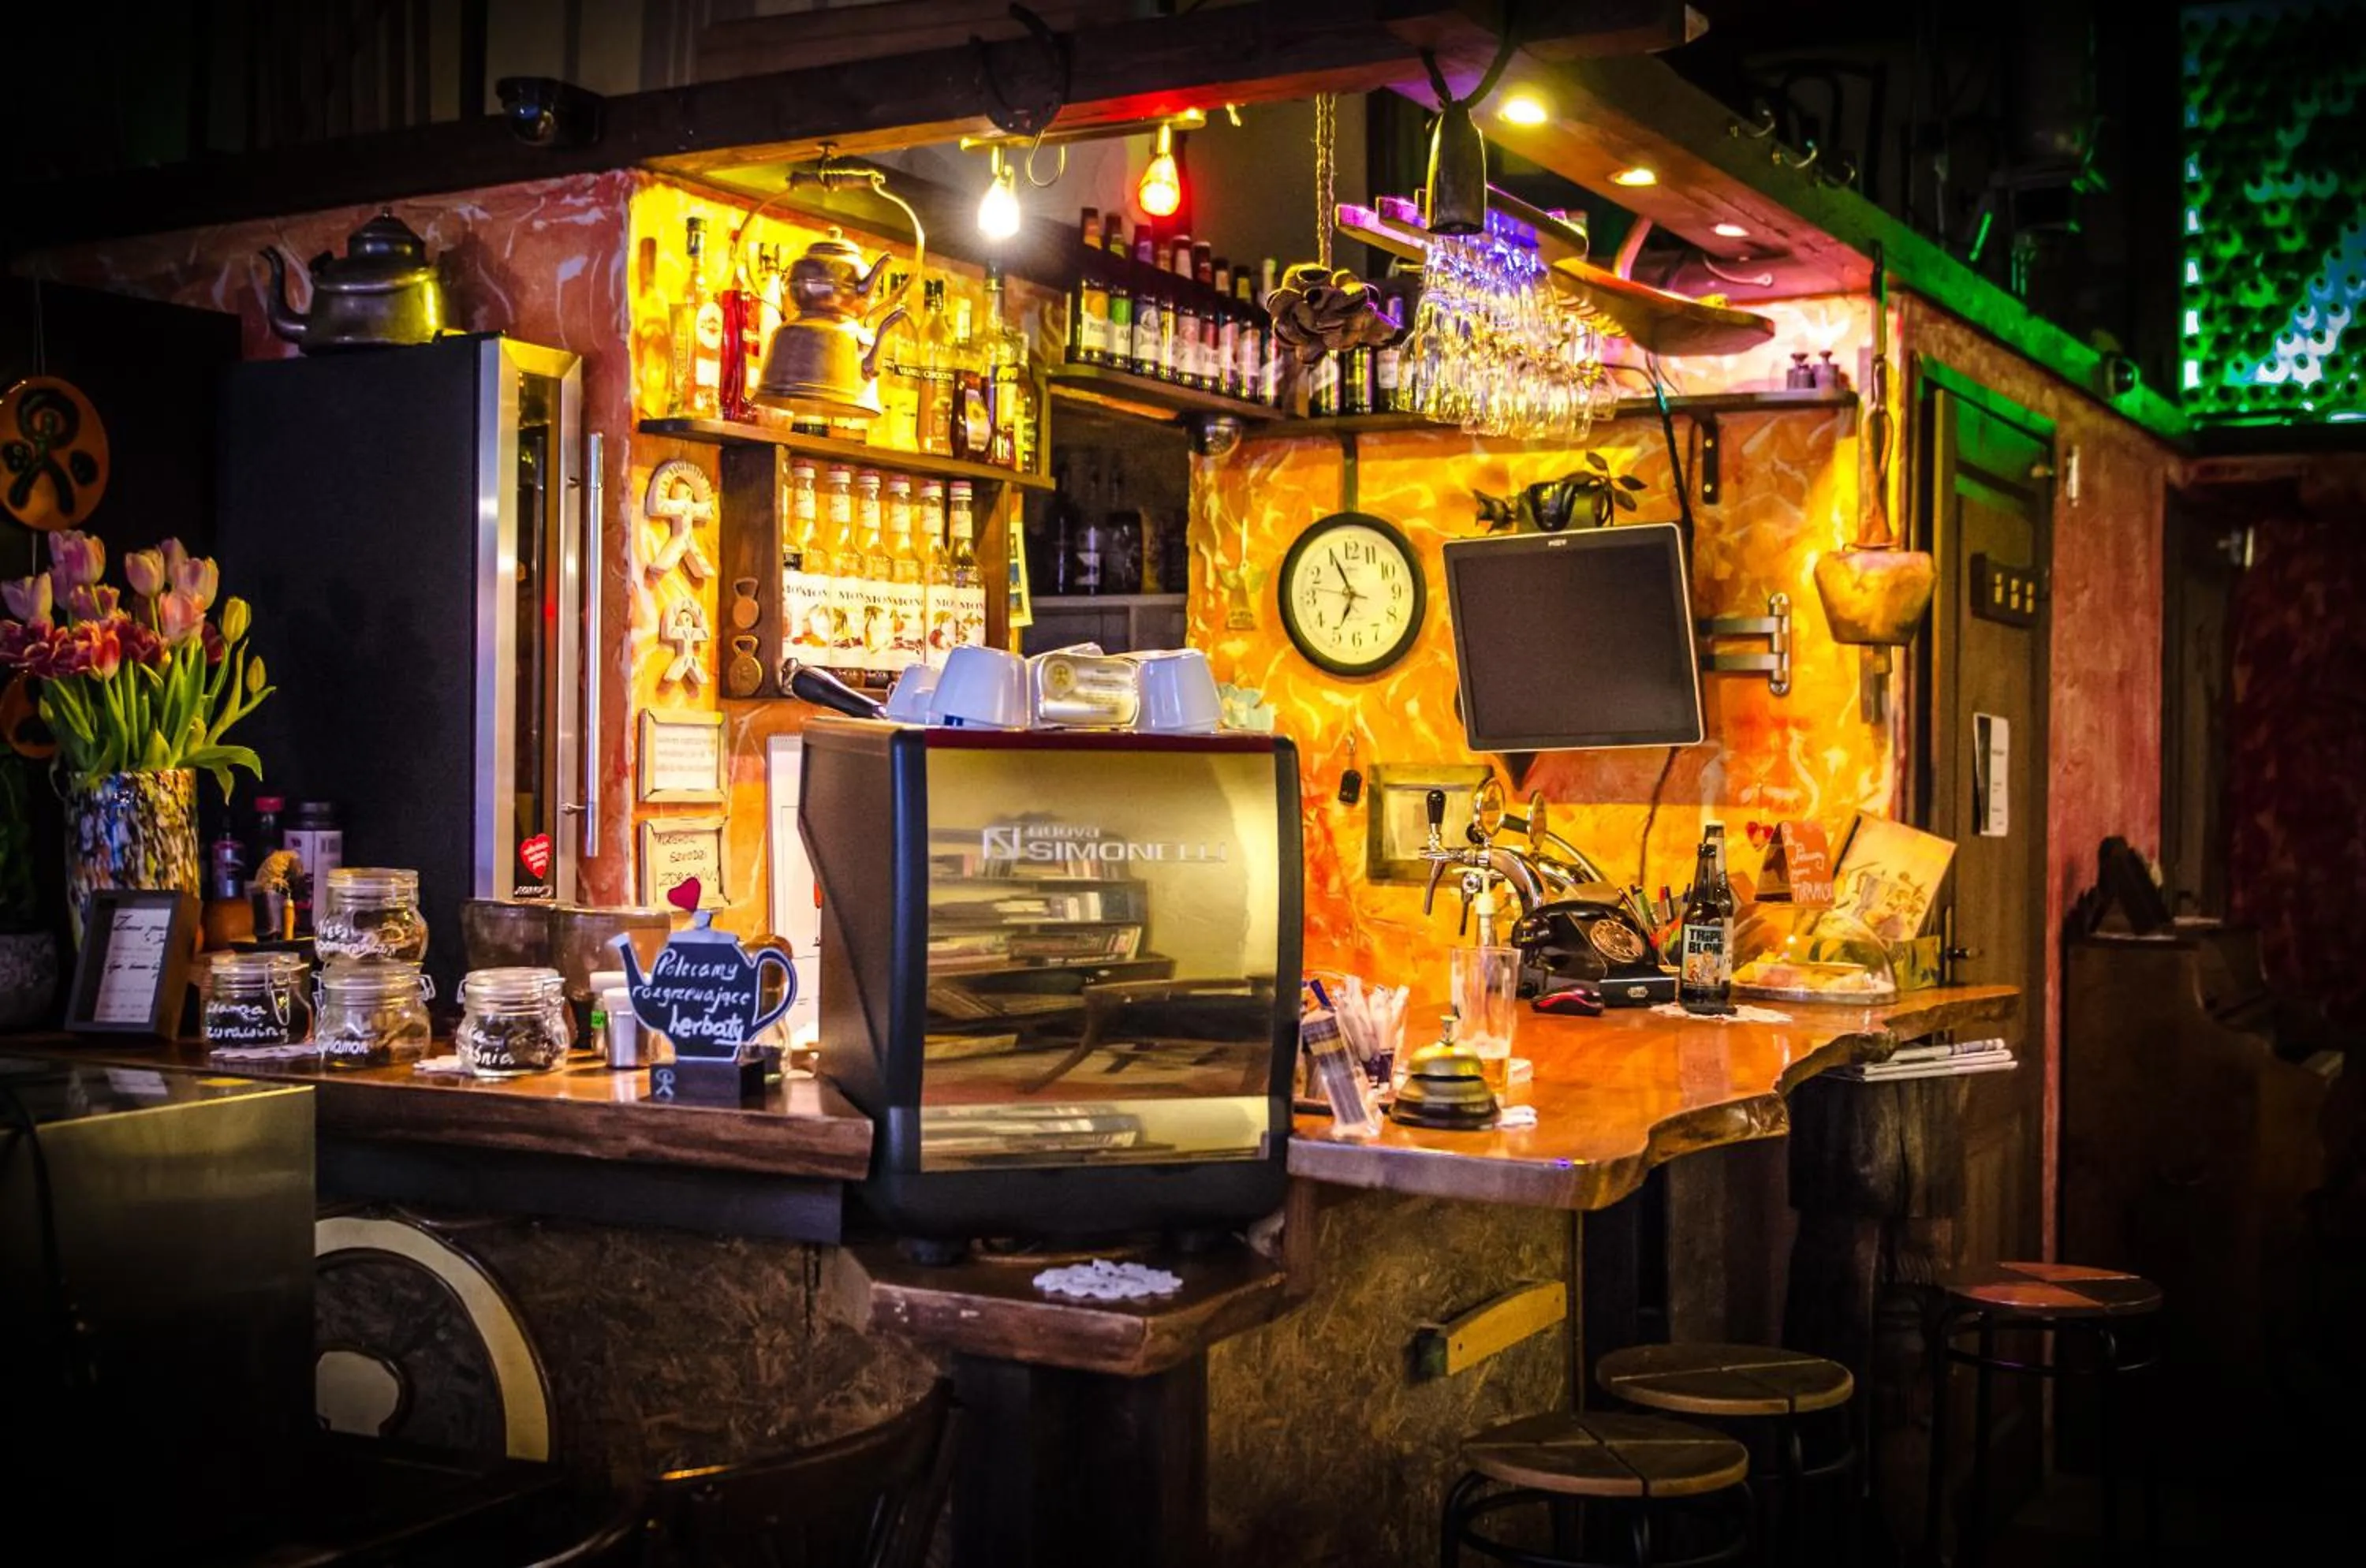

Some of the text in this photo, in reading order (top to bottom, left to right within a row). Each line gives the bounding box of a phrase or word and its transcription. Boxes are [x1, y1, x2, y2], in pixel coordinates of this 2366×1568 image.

[1345, 541, 1360, 560] 12
[1365, 546, 1376, 565] 11
[1311, 566, 1321, 584] 2
[1381, 561, 1395, 581] 10
[1306, 589, 1316, 607] 3
[1391, 583, 1401, 601] 9
[1316, 610, 1325, 628] 4
[1386, 607, 1398, 623] 8
[1332, 626, 1342, 644] 5
[1352, 632, 1362, 648] 6
[1371, 623, 1380, 642] 7
[657, 948, 739, 981] Polecamy
[669, 1004, 745, 1045] herbaty
